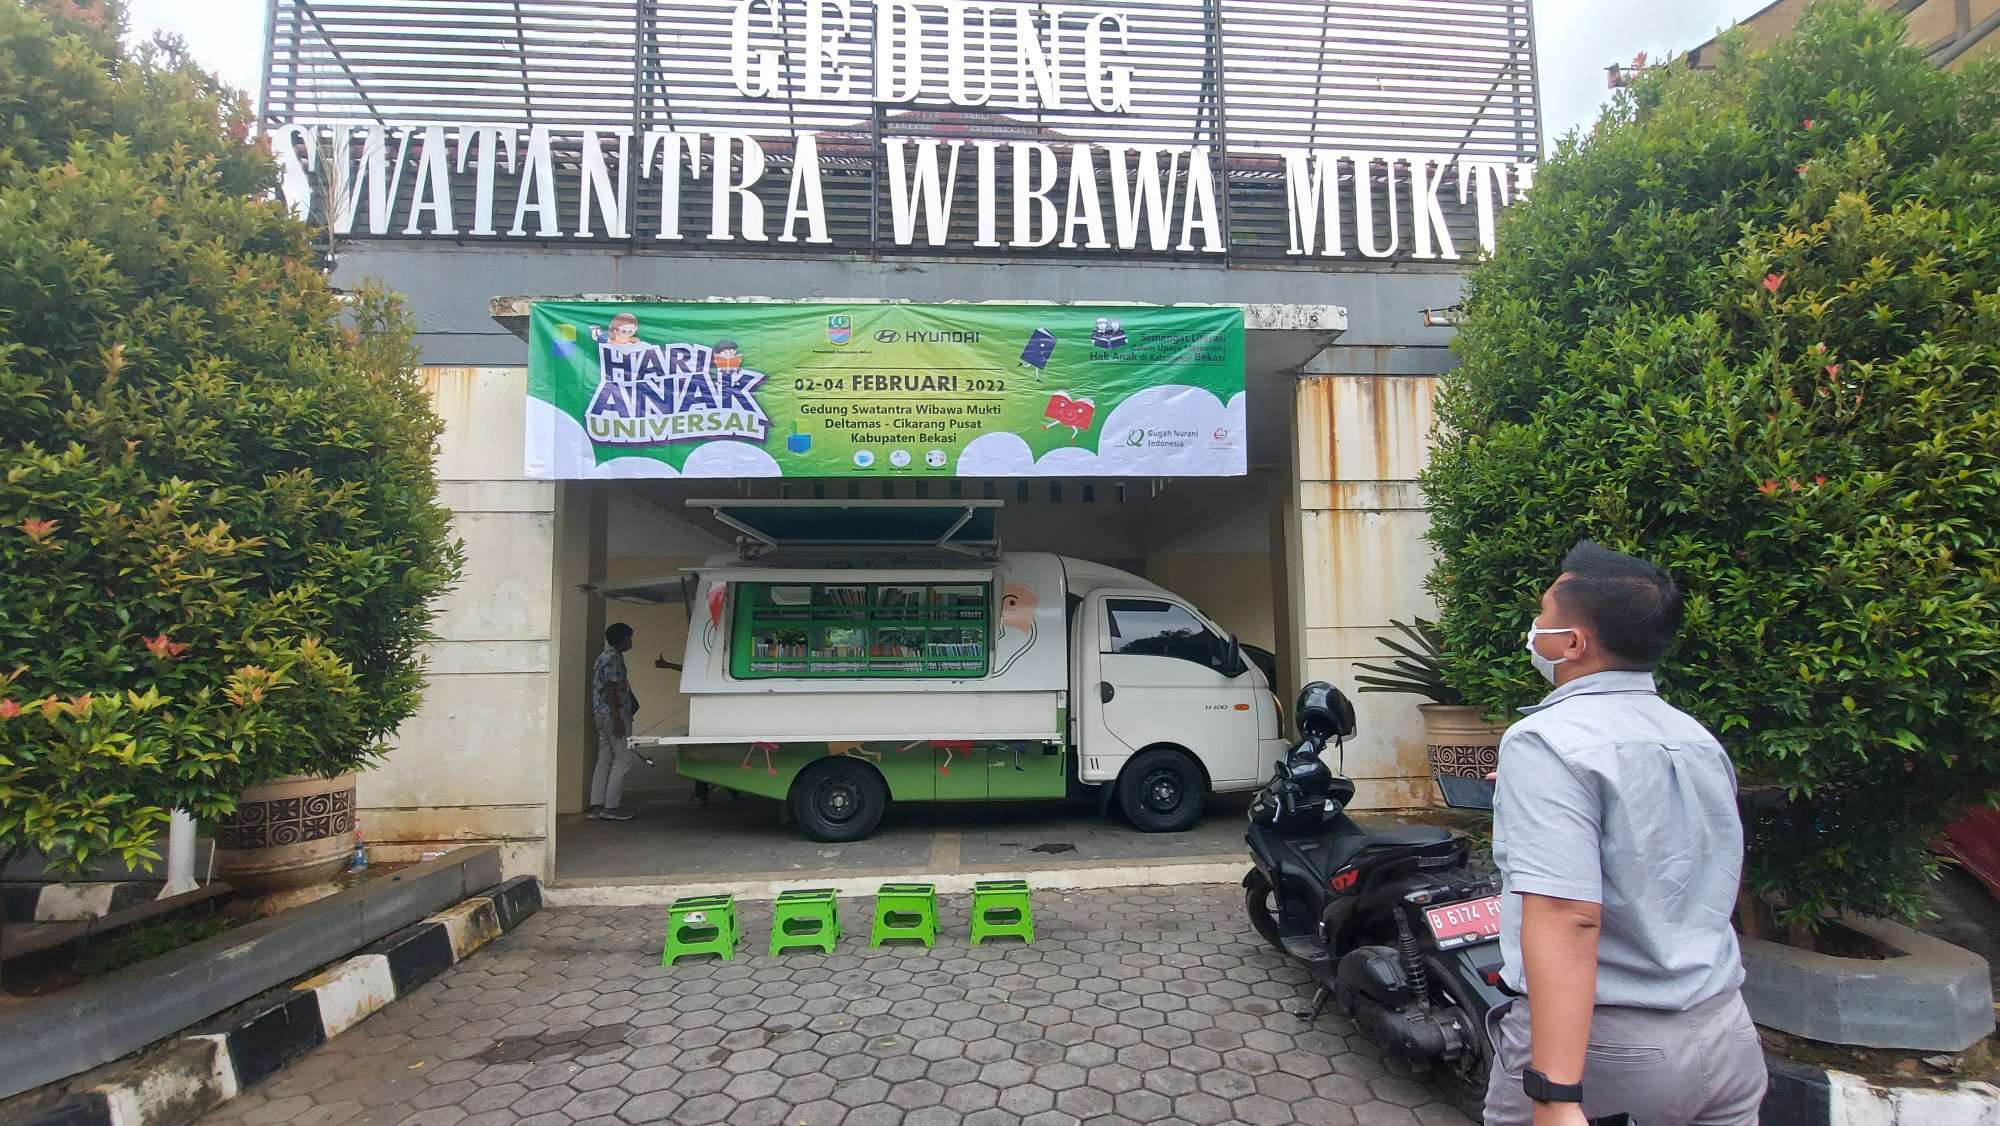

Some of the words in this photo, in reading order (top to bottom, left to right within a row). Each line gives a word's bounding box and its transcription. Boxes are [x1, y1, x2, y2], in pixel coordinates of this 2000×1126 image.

[731, 0, 1135, 113] GEDUNG
[271, 124, 832, 244] SWATANTRA
[881, 137, 1228, 254] WIBAWA
[905, 331, 980, 344] HYUNDAI
[602, 346, 706, 382] HARI
[1090, 351, 1110, 361] Hak
[1112, 351, 1138, 361] Anak
[1194, 352, 1226, 362] Bekasi
[794, 378, 844, 391] 02-04
[852, 374, 958, 392] FEBRUARI
[965, 379, 1006, 392] 2022
[590, 371, 757, 419] ANAK
[800, 404, 848, 418] Gedung
[852, 404, 912, 415] Swatantra
[915, 403, 963, 415] Wibawa
[966, 403, 1001, 415] Mukti
[590, 411, 759, 438] UNIVERSAL
[825, 418, 882, 429] Deltamas
[893, 418, 946, 432] Cikarang
[949, 418, 982, 429] Pusat
[851, 432, 916, 446] Kabupaten
[919, 432, 957, 444] Bekasi
[1147, 429, 1172, 439] Gugah
[1173, 430, 1199, 438] Nurani
[1148, 440, 1184, 448] Indonesia
[1431, 914, 1443, 929] B
[1446, 904, 1481, 926] 6174
